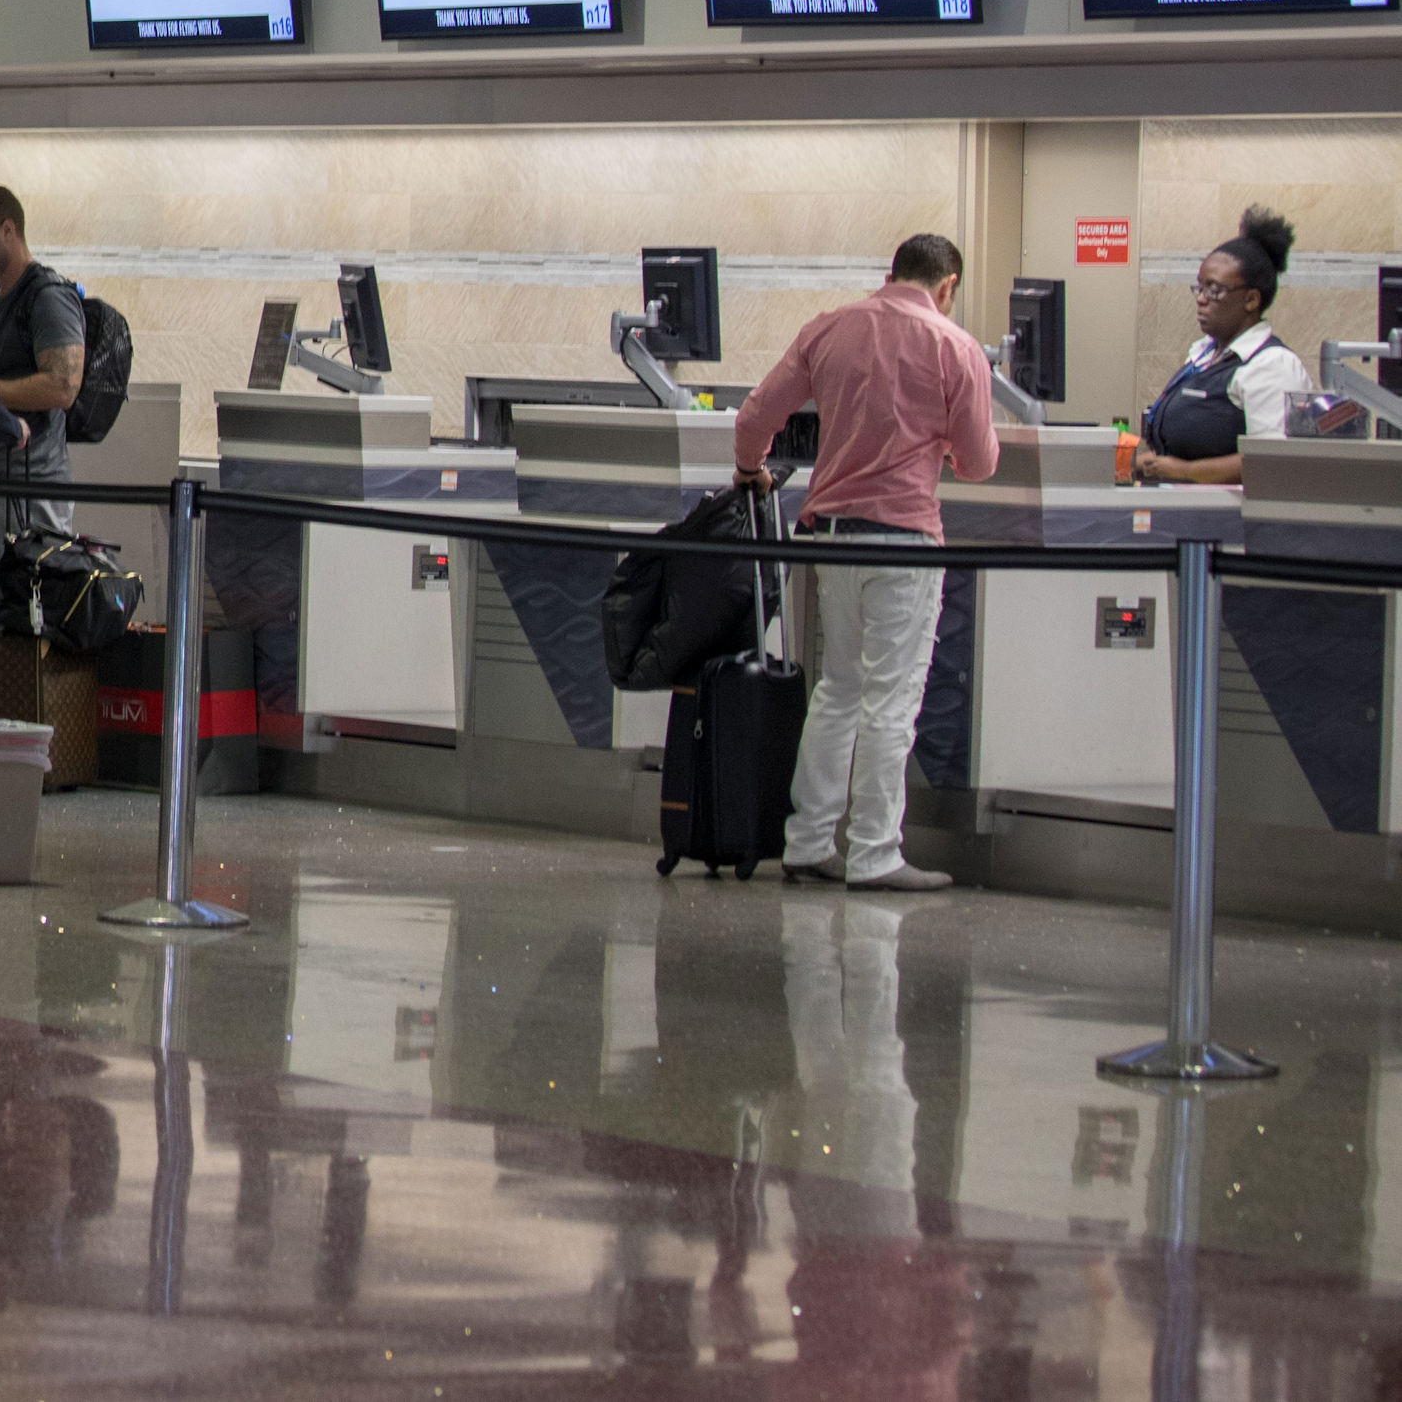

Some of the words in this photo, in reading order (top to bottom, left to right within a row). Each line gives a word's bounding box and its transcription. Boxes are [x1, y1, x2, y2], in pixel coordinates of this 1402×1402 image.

[435, 9, 456, 27] THANK
[456, 9, 469, 26] YOU
[469, 9, 482, 26] FOR
[482, 8, 502, 26] FLYING
[503, 7, 518, 25] WITH
[519, 7, 530, 24] US.
[586, 4, 608, 24] n17
[138, 21, 156, 38] THANK
[156, 21, 167, 37] YOU
[167, 21, 178, 37] FOR
[179, 20, 198, 37] FLYING
[197, 19, 212, 36] WITH
[211, 19, 222, 35] US.
[272, 16, 293, 36] n16
[1078, 224, 1109, 236] SECURED
[1109, 224, 1127, 236] AREA
[1096, 247, 1108, 260] Only
